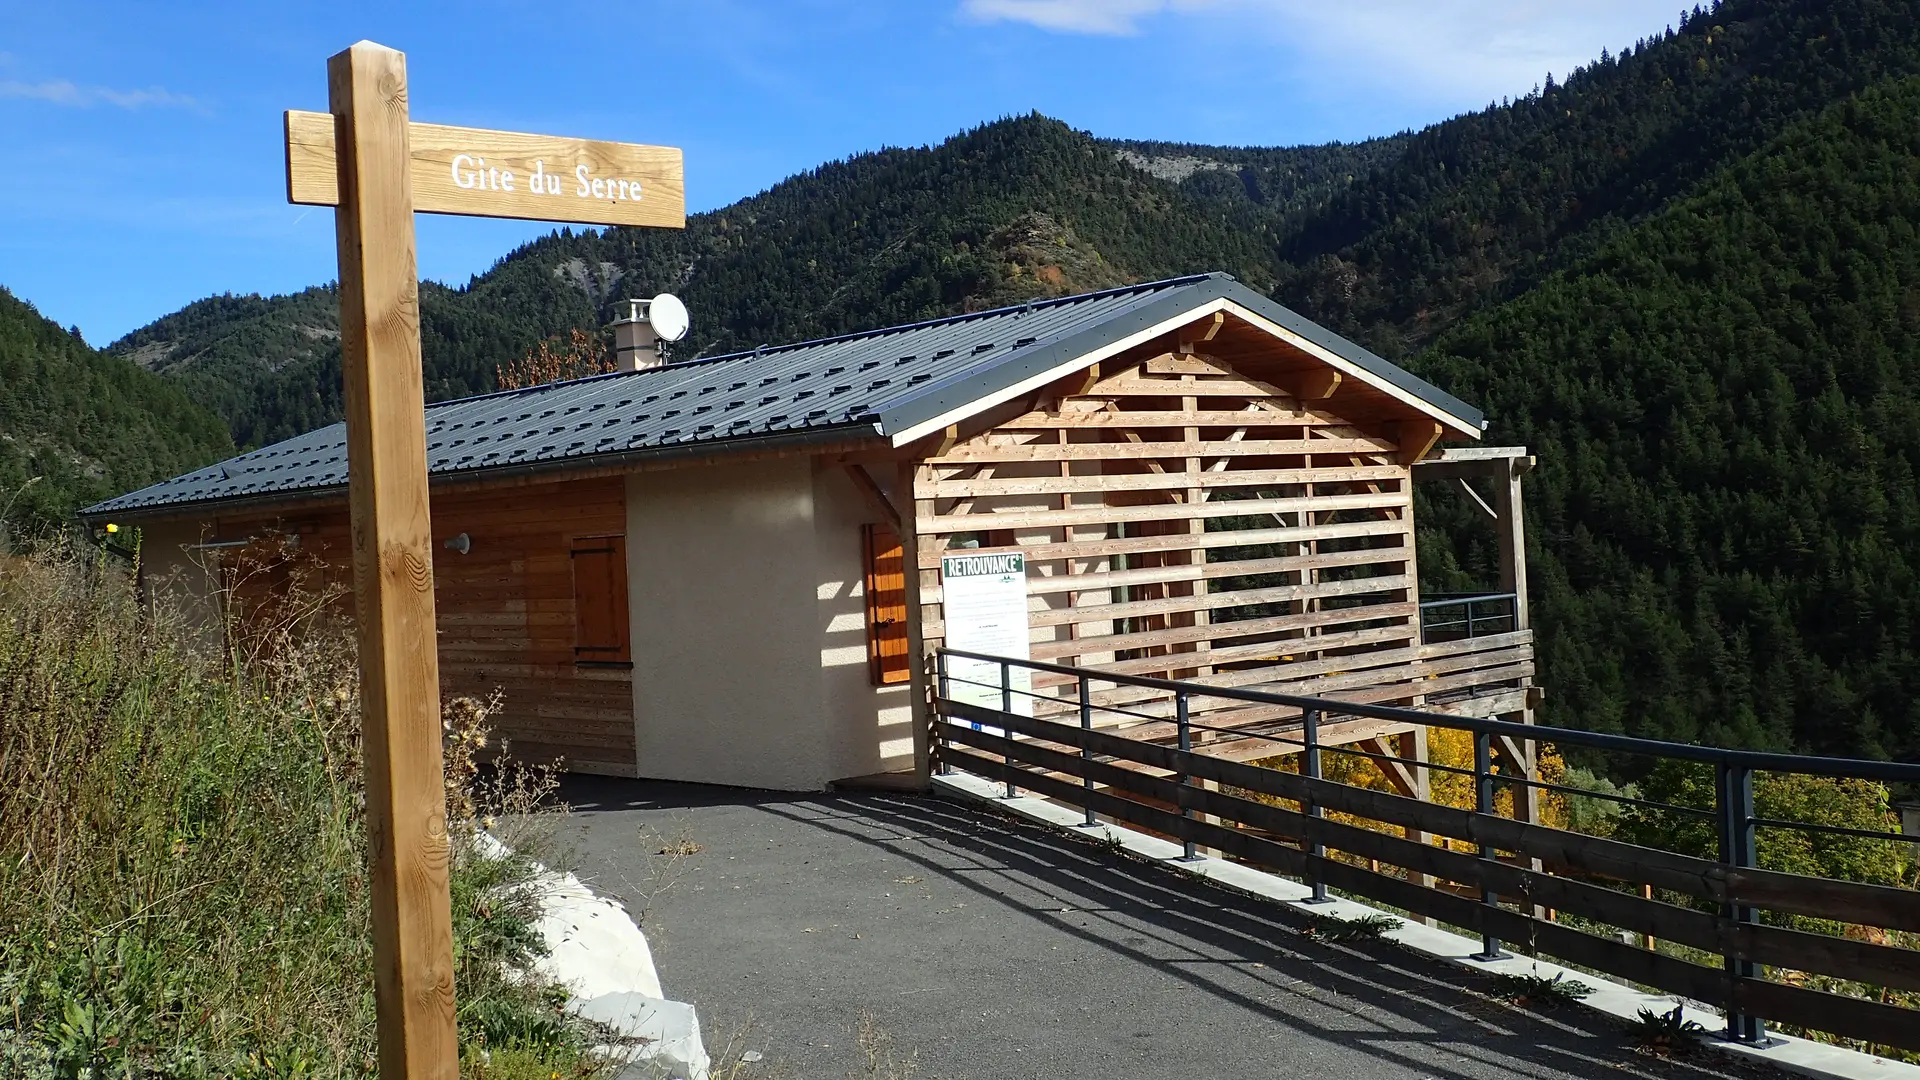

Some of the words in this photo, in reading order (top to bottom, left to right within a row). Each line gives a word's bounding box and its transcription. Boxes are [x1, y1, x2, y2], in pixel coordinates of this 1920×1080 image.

[451, 153, 515, 191] Gite
[529, 159, 562, 195] du
[575, 163, 643, 200] Serre
